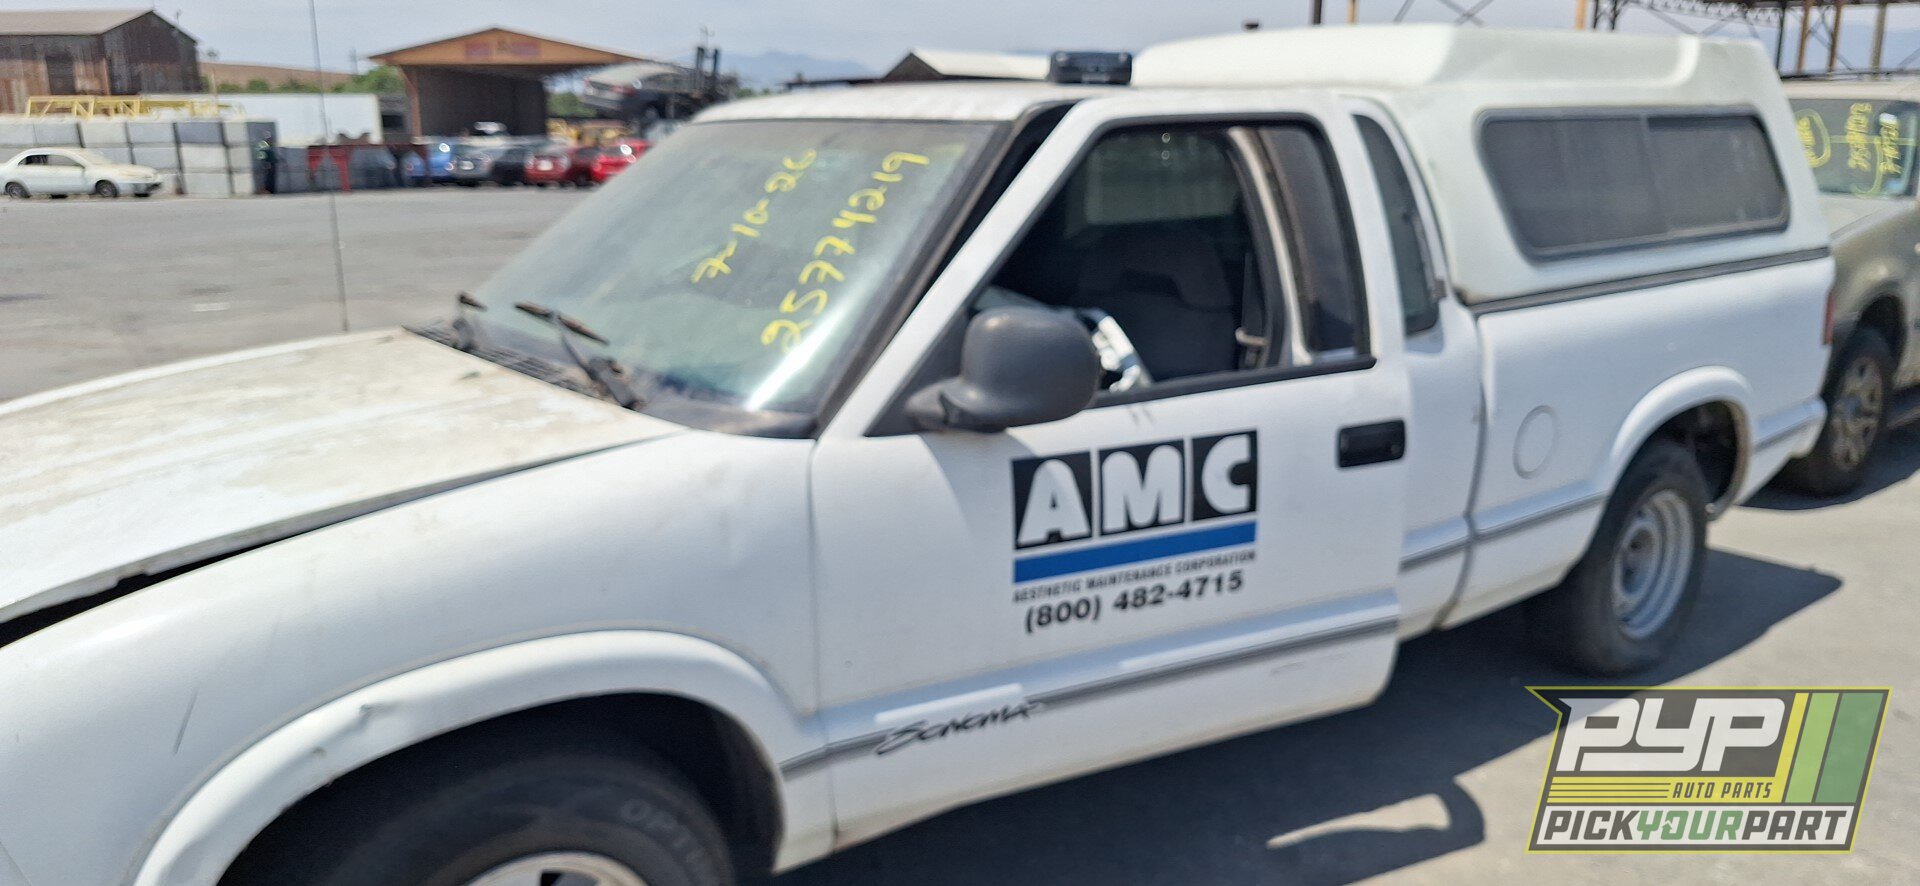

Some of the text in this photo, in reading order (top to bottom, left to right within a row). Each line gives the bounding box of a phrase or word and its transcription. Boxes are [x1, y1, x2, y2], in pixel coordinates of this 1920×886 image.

[761, 151, 930, 354] 25774219
[1014, 433, 1251, 548] AMC
[1013, 549, 1256, 603] AESTHETIC MAINTENANCE CORPORATION
[1025, 568, 1243, 633] (800) 482-4715
